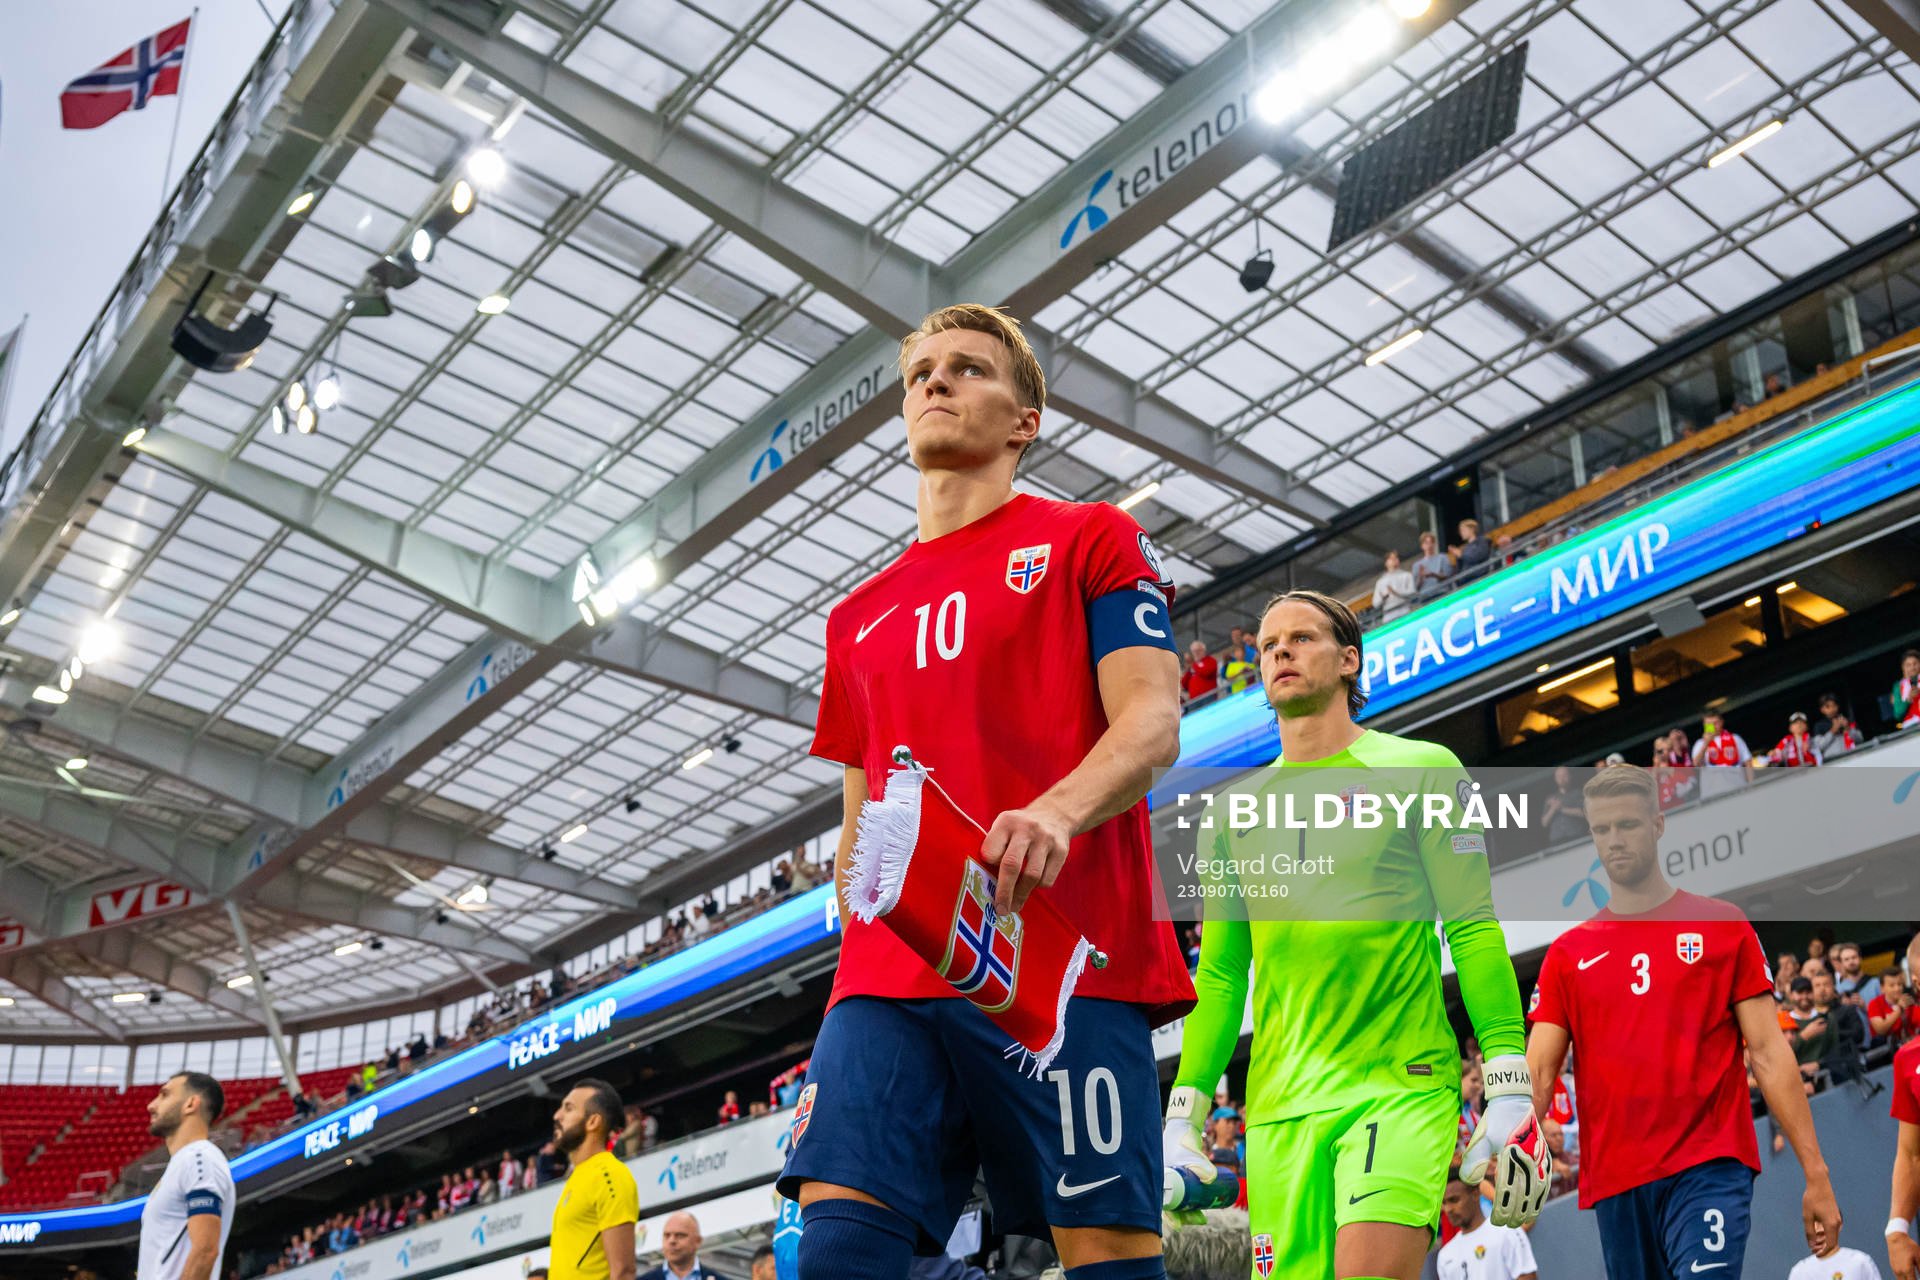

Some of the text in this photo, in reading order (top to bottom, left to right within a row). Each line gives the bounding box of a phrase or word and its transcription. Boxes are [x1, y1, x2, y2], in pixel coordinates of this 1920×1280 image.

[790, 365, 883, 455] telenor
[914, 591, 967, 669] 10
[1134, 602, 1166, 639] C
[1361, 597, 1500, 694] PEACE
[1550, 522, 1670, 615] МИР
[1665, 827, 1750, 877] enor
[95, 881, 187, 922] VG
[1630, 953, 1651, 996] 3
[509, 1022, 560, 1070] PEACE
[574, 997, 617, 1041] МИР
[1047, 1066, 1122, 1155] 10
[678, 1151, 727, 1180] telenor
[1364, 1122, 1378, 1173] 1
[1703, 1208, 1726, 1252] 3
